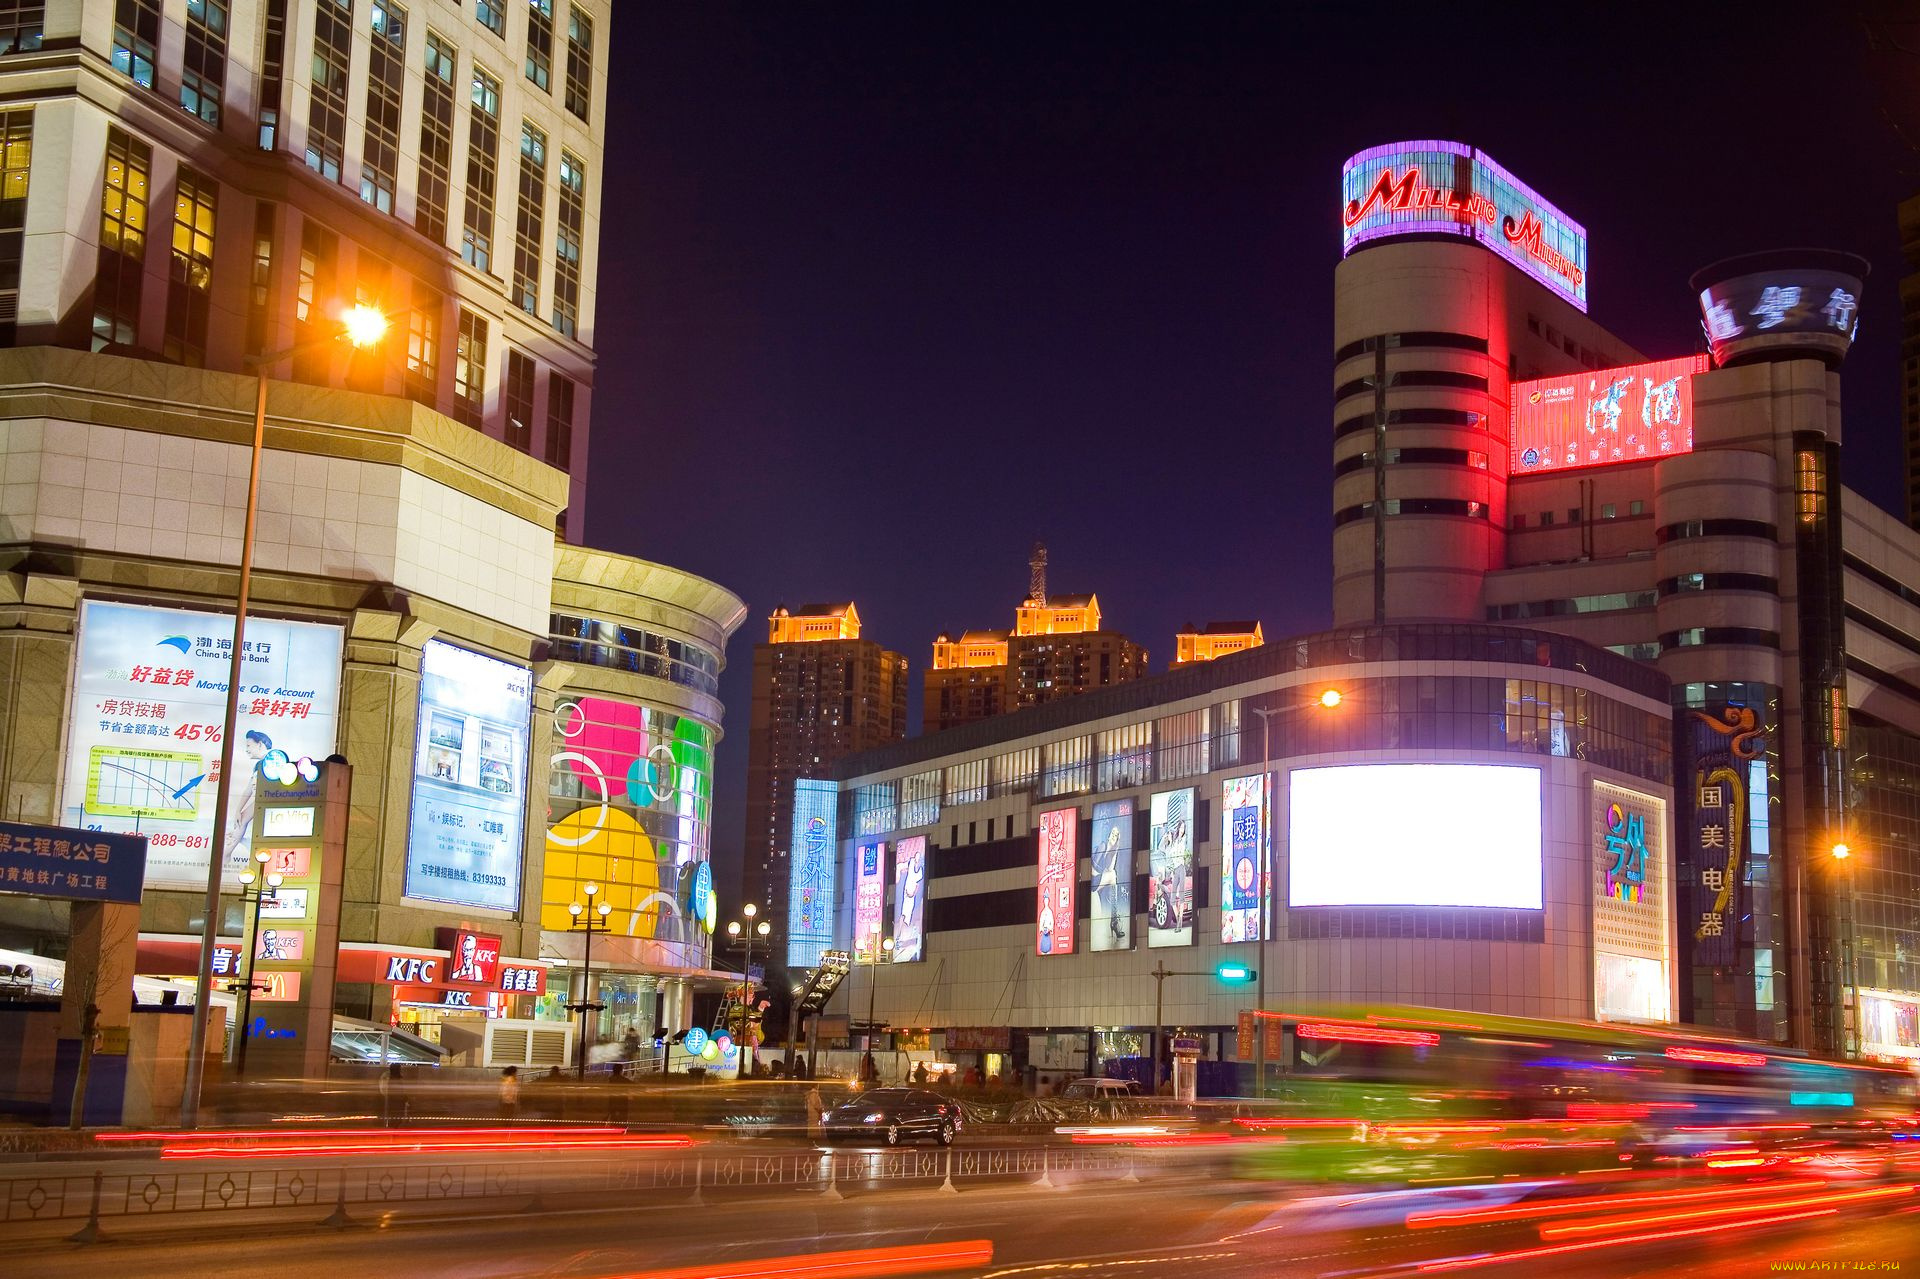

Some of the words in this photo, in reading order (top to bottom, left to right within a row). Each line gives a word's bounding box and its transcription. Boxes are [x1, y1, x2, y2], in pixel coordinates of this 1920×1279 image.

[195, 649, 220, 659] China
[249, 654, 270, 664] Bank
[195, 680, 246, 692] Mortge
[249, 685, 271, 694] One
[273, 688, 316, 698] Account
[101, 699, 167, 719] 房贷按揭
[99, 720, 170, 737] 节省金额高达
[173, 723, 222, 743] 45%
[1700, 786, 1725, 937] 国美电器
[472, 872, 506, 887] 83193333
[277, 937, 298, 948] KFC
[474, 949, 497, 963] KFC
[386, 957, 437, 984] KFC
[502, 967, 540, 992] 肯德基
[444, 990, 472, 1006] KFC
